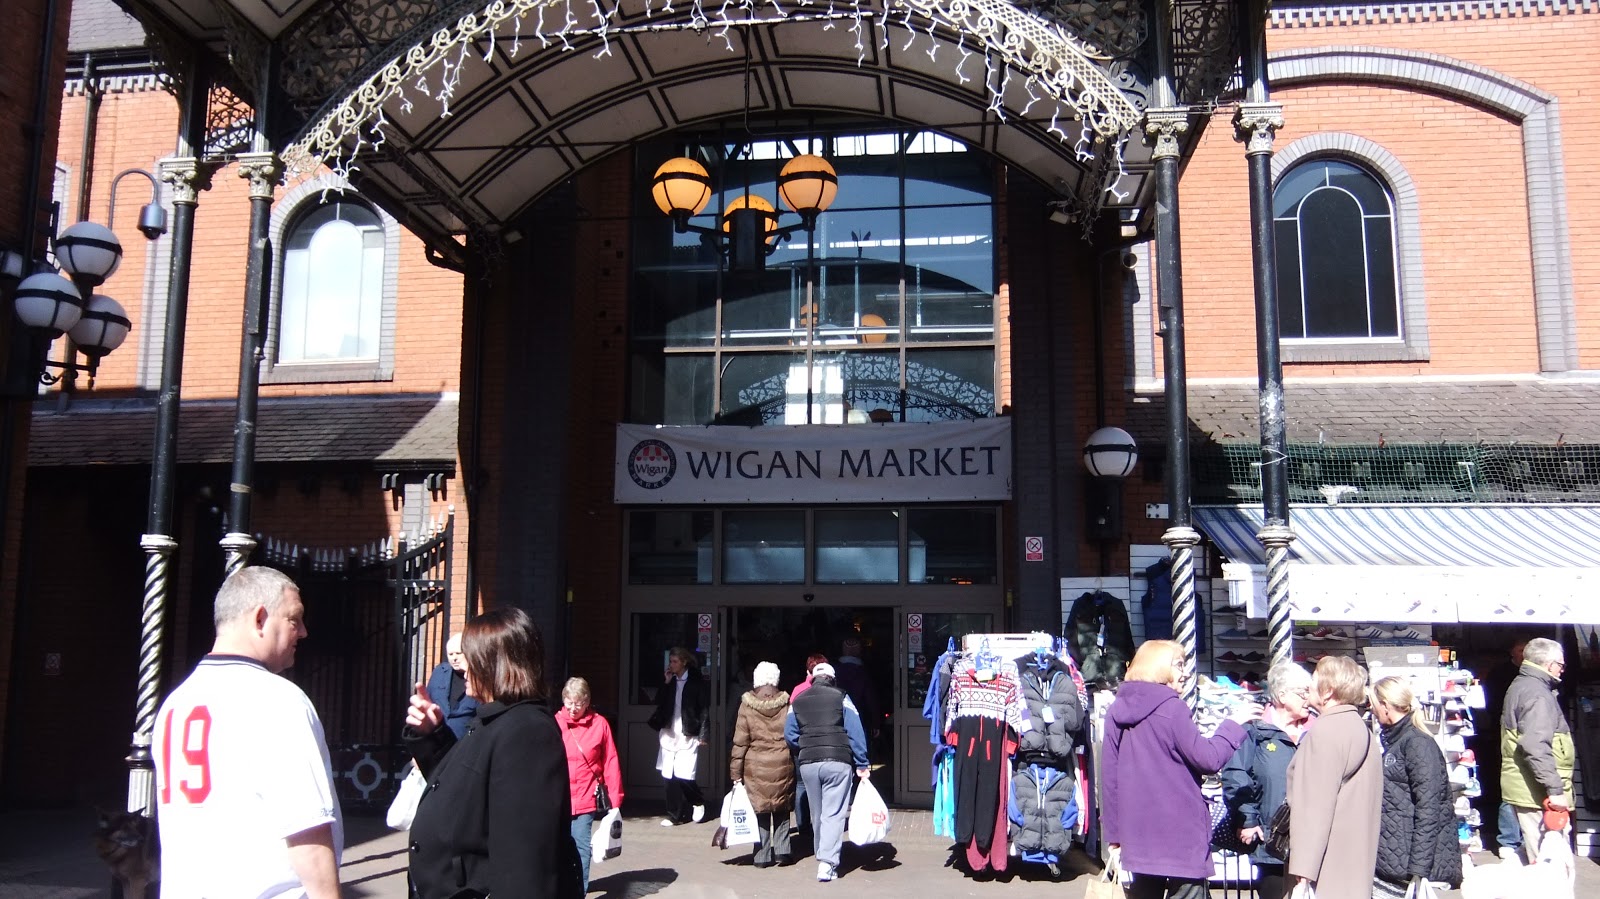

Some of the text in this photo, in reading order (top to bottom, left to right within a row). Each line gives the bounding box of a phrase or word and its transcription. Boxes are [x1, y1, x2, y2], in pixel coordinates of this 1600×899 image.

[635, 464, 668, 477] Wigan
[686, 446, 1000, 479] WIGAN MARKET
[632, 474, 672, 488] MARKET
[161, 705, 212, 804] 19
